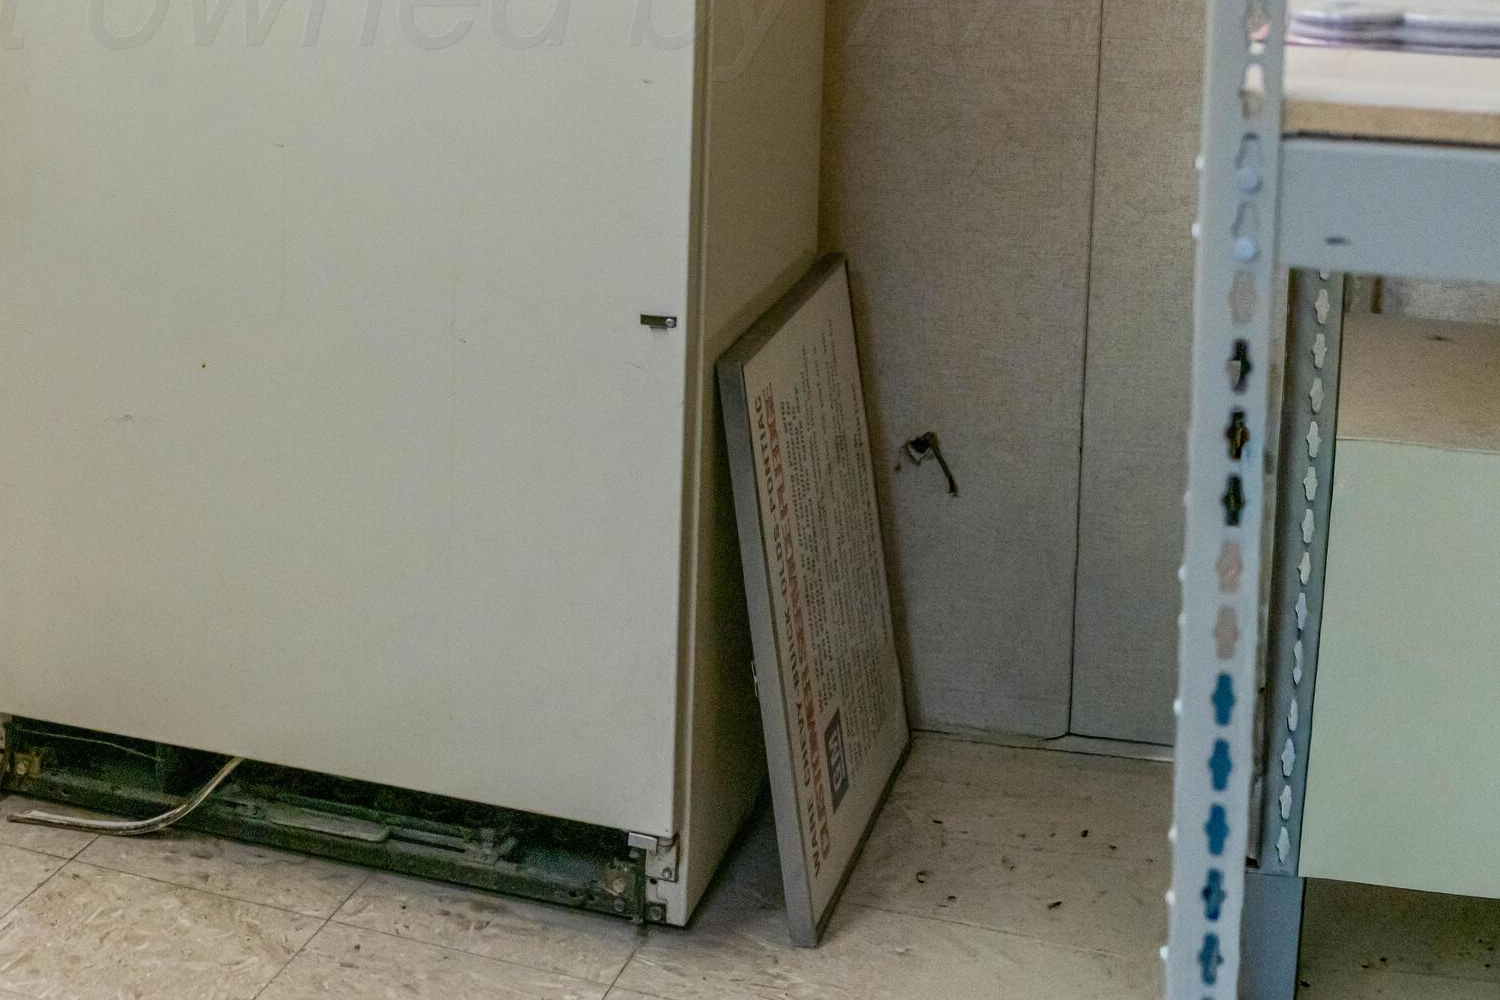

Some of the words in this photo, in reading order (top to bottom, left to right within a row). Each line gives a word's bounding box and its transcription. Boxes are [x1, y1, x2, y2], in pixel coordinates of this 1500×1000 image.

[762, 379, 788, 522] PLEDGE
[781, 516, 807, 669] SERVICE
[798, 662, 831, 864] CUSTOMER
[827, 726, 843, 797] GM
[806, 793, 821, 879] WARE
